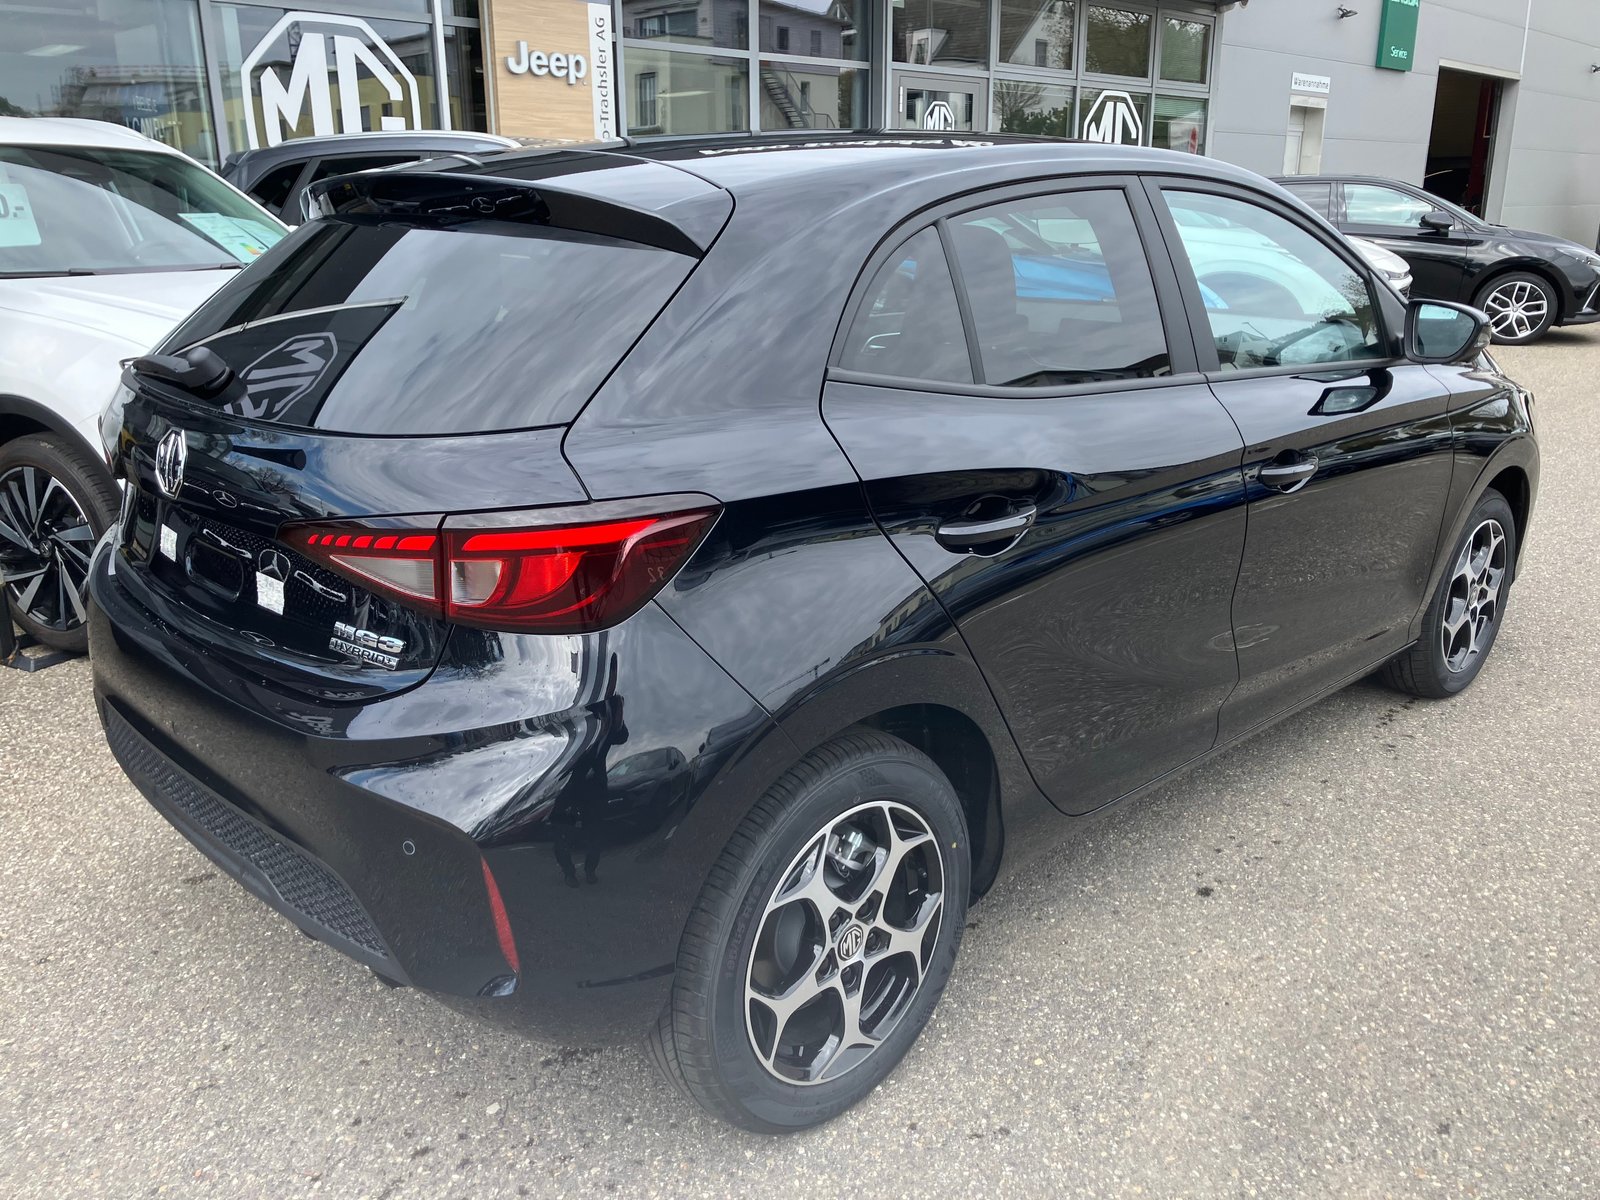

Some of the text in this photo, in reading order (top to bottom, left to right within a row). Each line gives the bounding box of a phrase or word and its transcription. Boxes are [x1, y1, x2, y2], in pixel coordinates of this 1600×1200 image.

[595, 17, 606, 41] AG
[504, 40, 588, 85] Jeep
[1390, 46, 1408, 59] Service
[259, 32, 406, 148] MG
[329, 637, 399, 670] HYBRID+
[842, 930, 862, 957] MG
